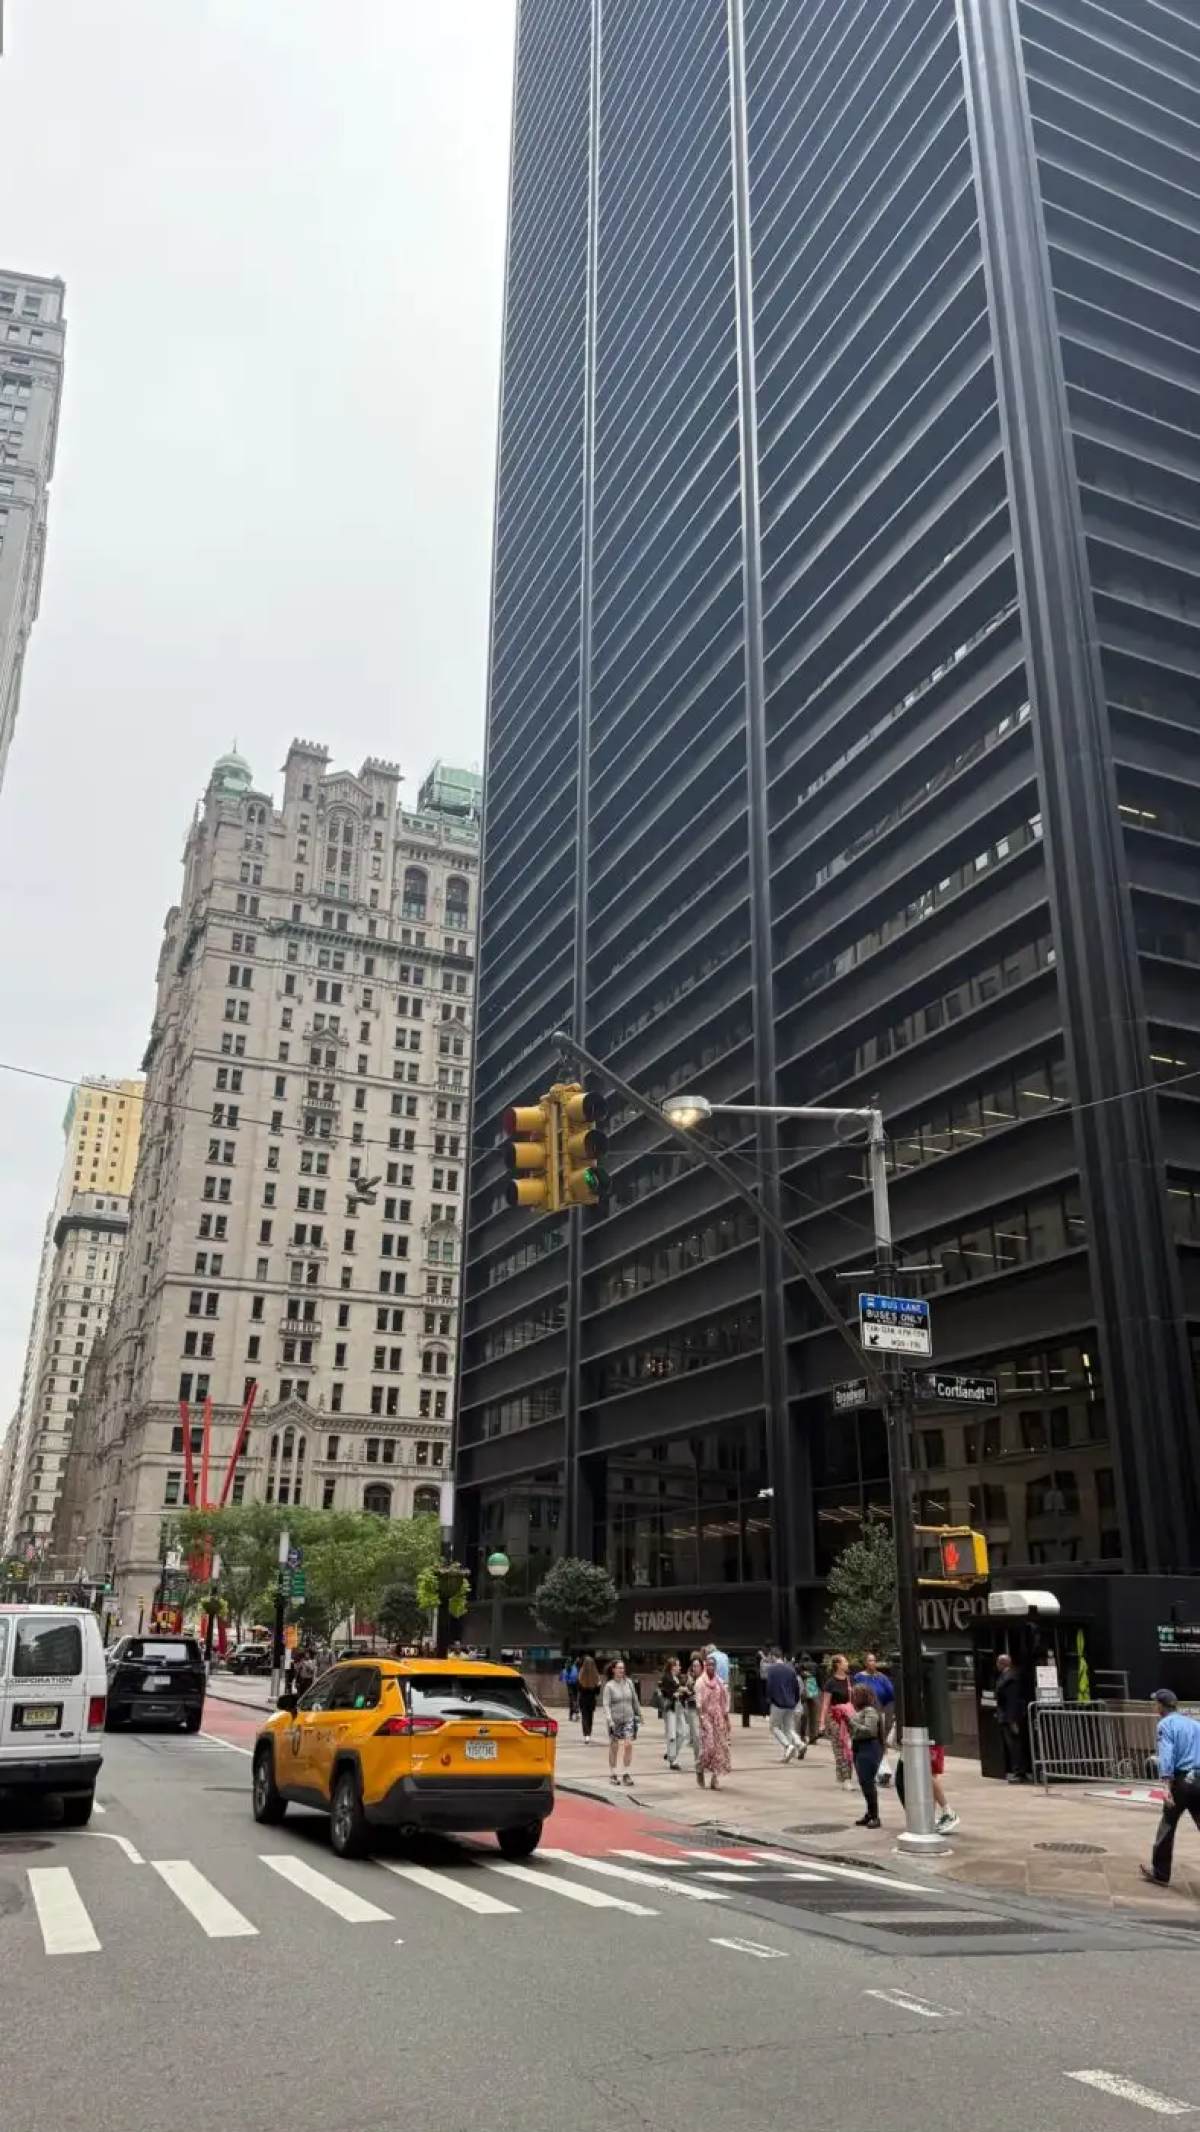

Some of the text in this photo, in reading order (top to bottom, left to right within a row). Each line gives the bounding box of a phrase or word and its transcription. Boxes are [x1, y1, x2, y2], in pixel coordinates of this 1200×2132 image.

[881, 1300, 922, 1313] BUS LANE
[866, 1309, 898, 1320] BUSES
[901, 1313, 924, 1324] ONLY
[937, 1382, 986, 1400] Cortlandt
[634, 1609, 711, 1632] STARBUCKS
